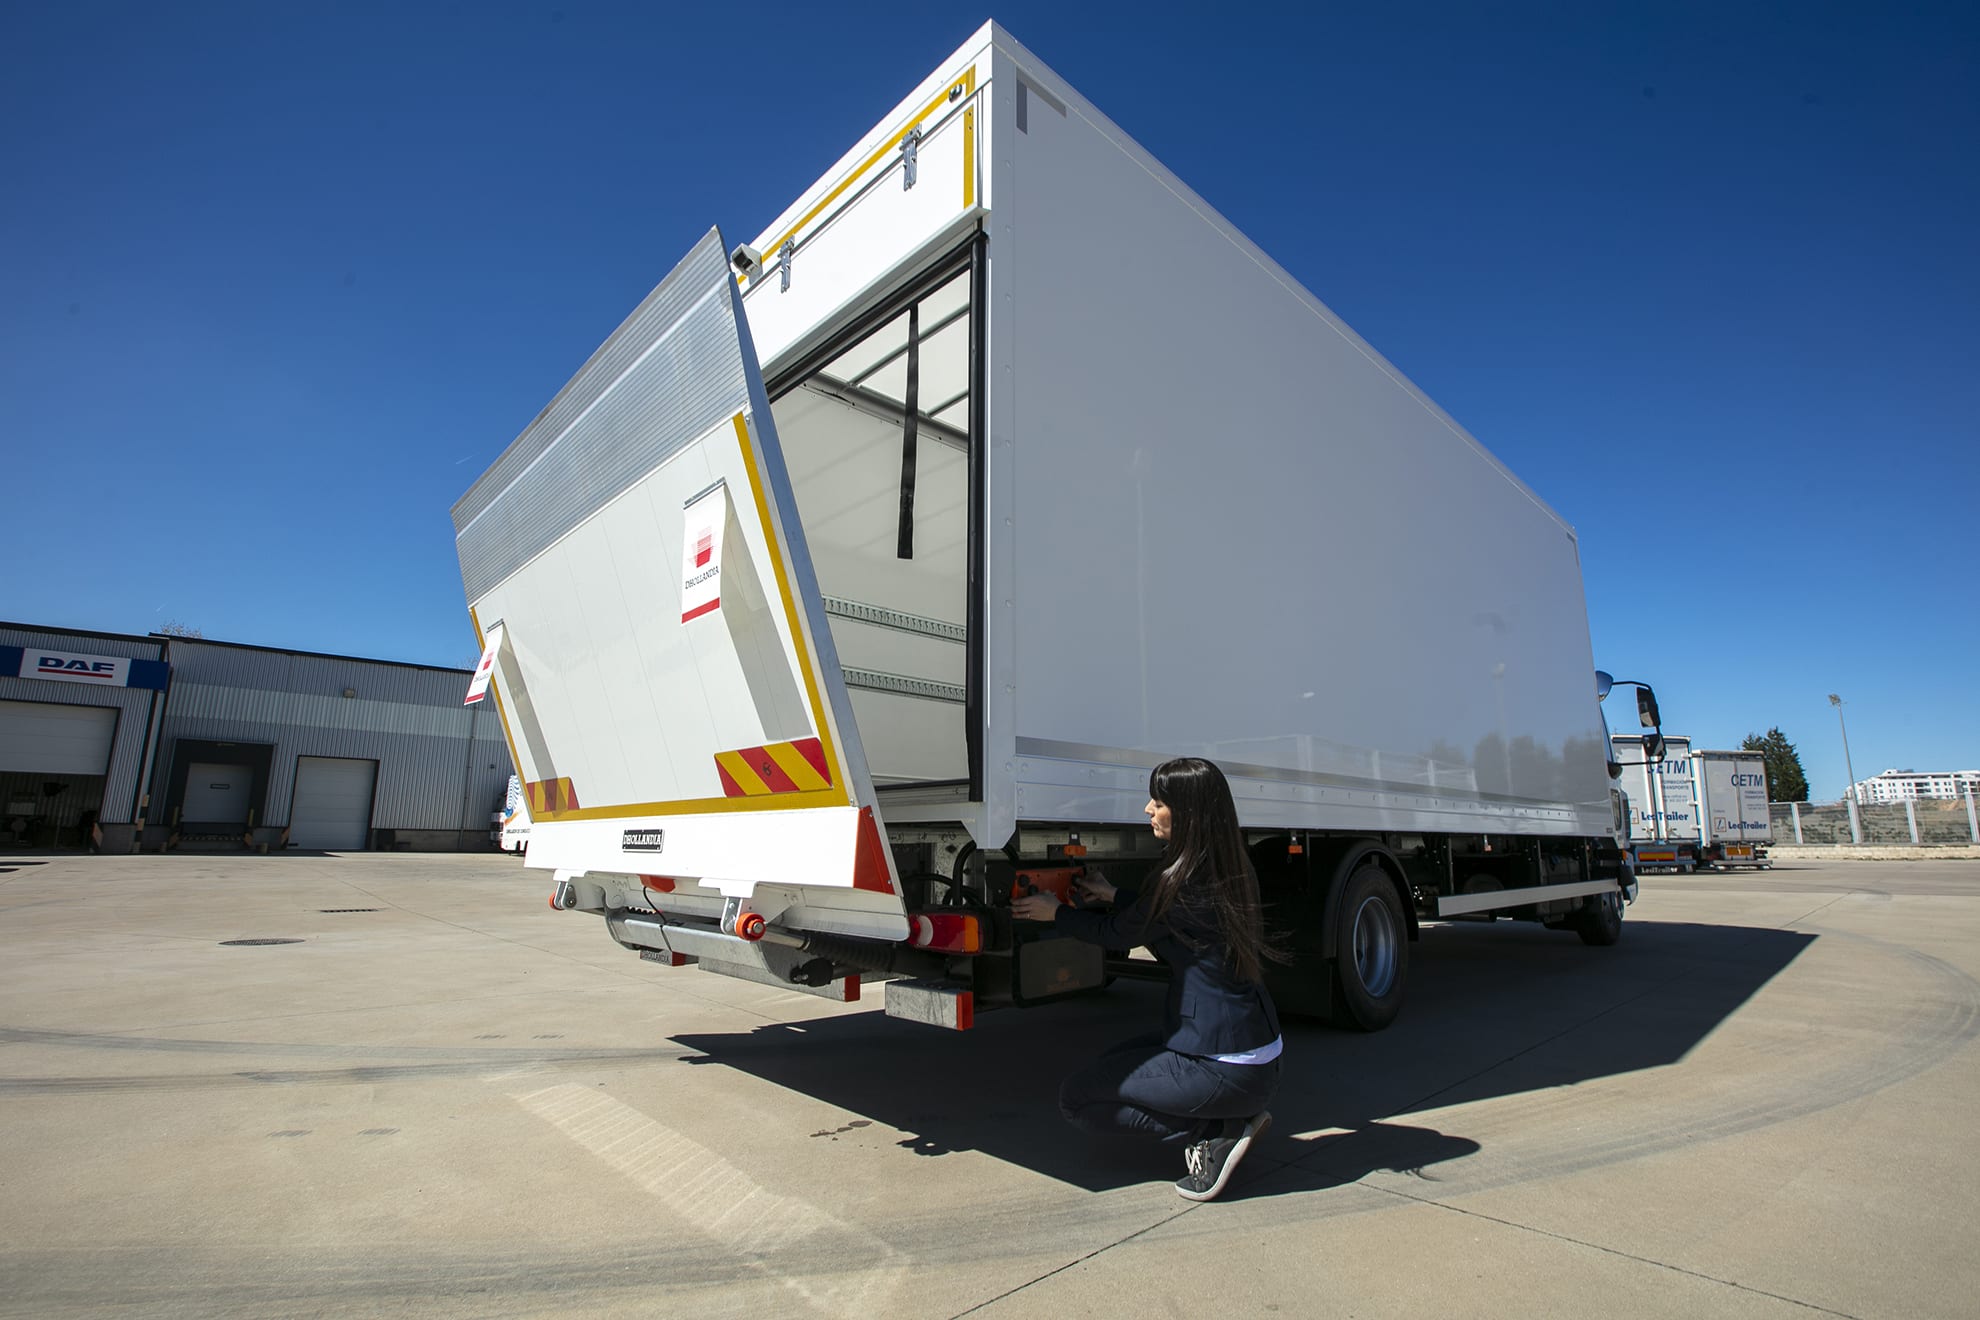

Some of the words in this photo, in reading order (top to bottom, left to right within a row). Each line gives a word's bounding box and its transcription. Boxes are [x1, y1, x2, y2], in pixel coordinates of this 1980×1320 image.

[38, 656, 115, 673] DAF
[1731, 774, 1763, 787] CETM
[623, 834, 661, 845] DHOLLANDIA
